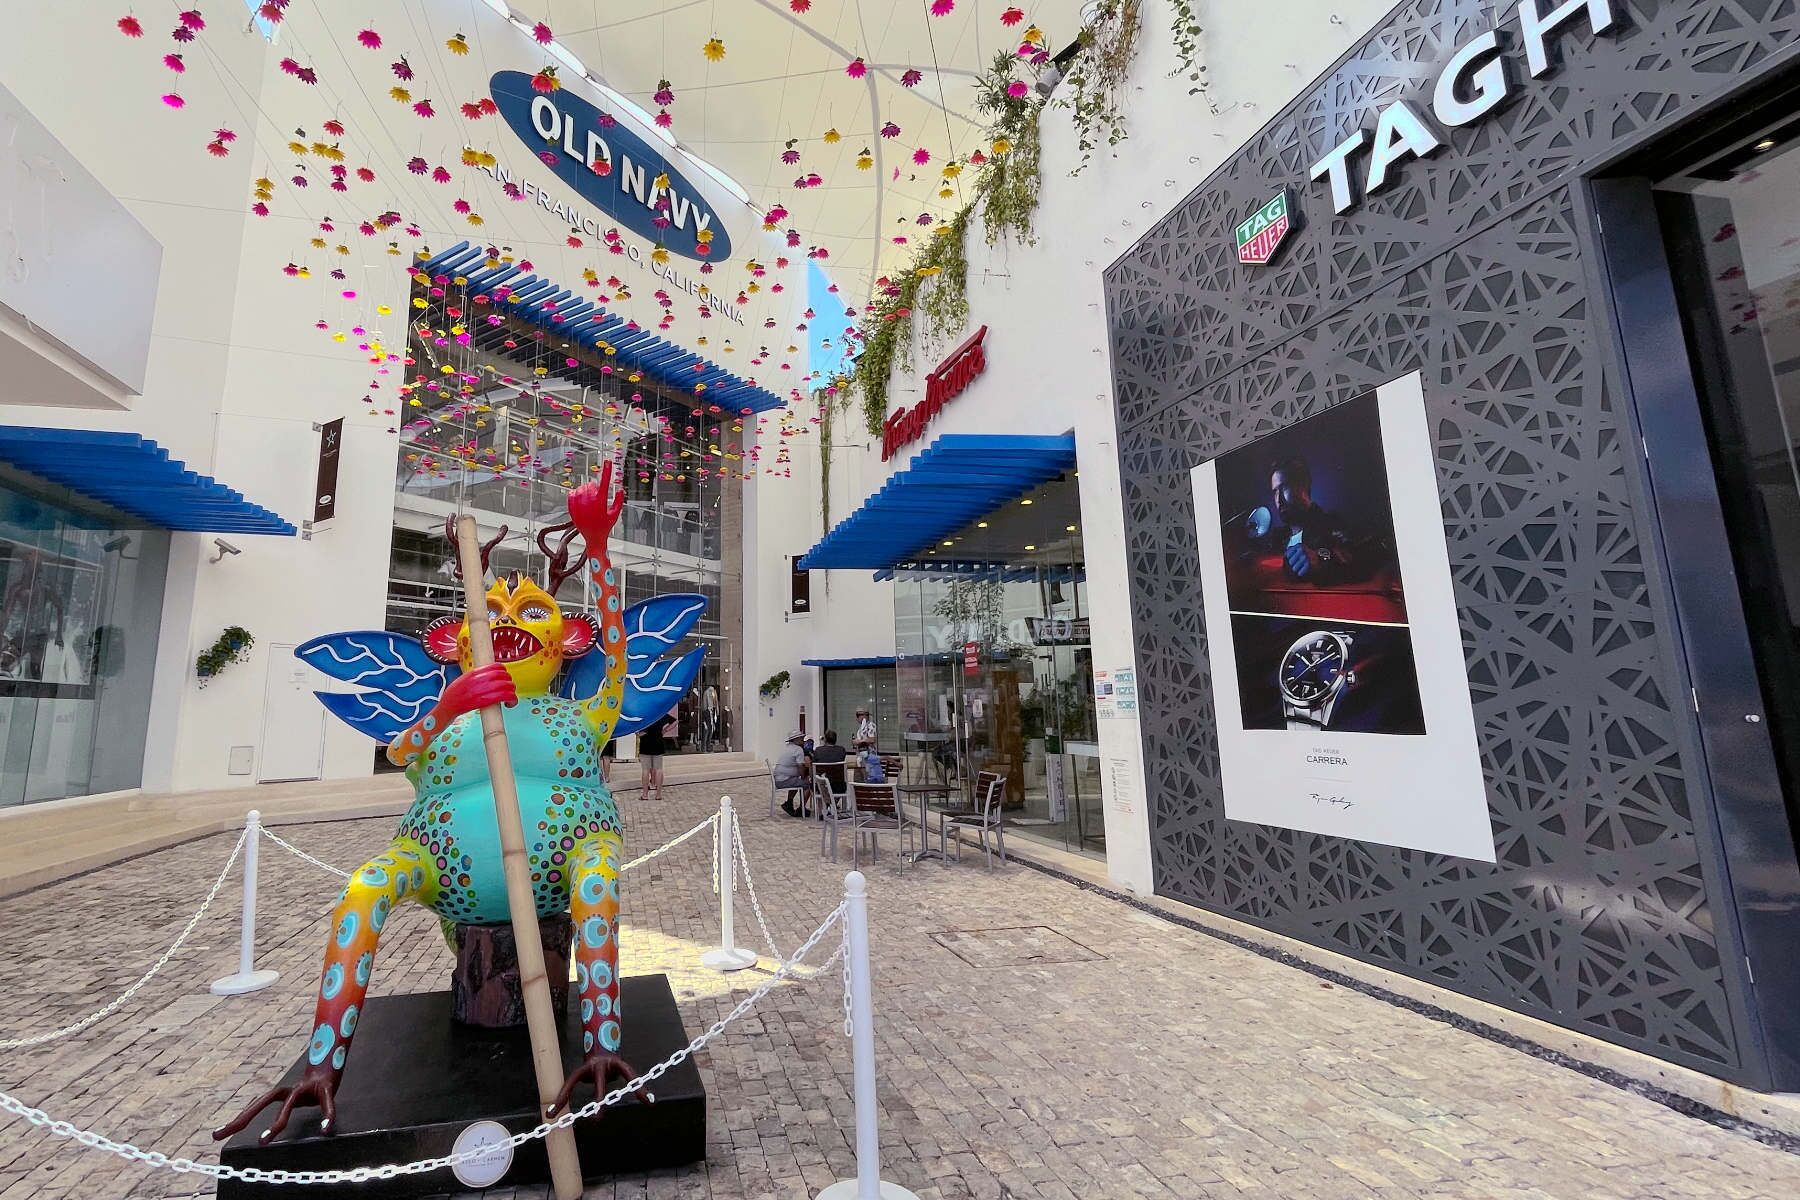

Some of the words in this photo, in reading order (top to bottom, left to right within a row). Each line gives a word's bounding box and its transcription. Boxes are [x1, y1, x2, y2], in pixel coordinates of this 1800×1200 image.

[531, 95, 613, 176] OLD
[621, 154, 711, 243] NAVY
[1239, 199, 1282, 241] TAG
[1241, 220, 1286, 259] HEUER
[652, 261, 745, 327] CALIFORNIA
[1306, 755, 1348, 766] CARRERA
